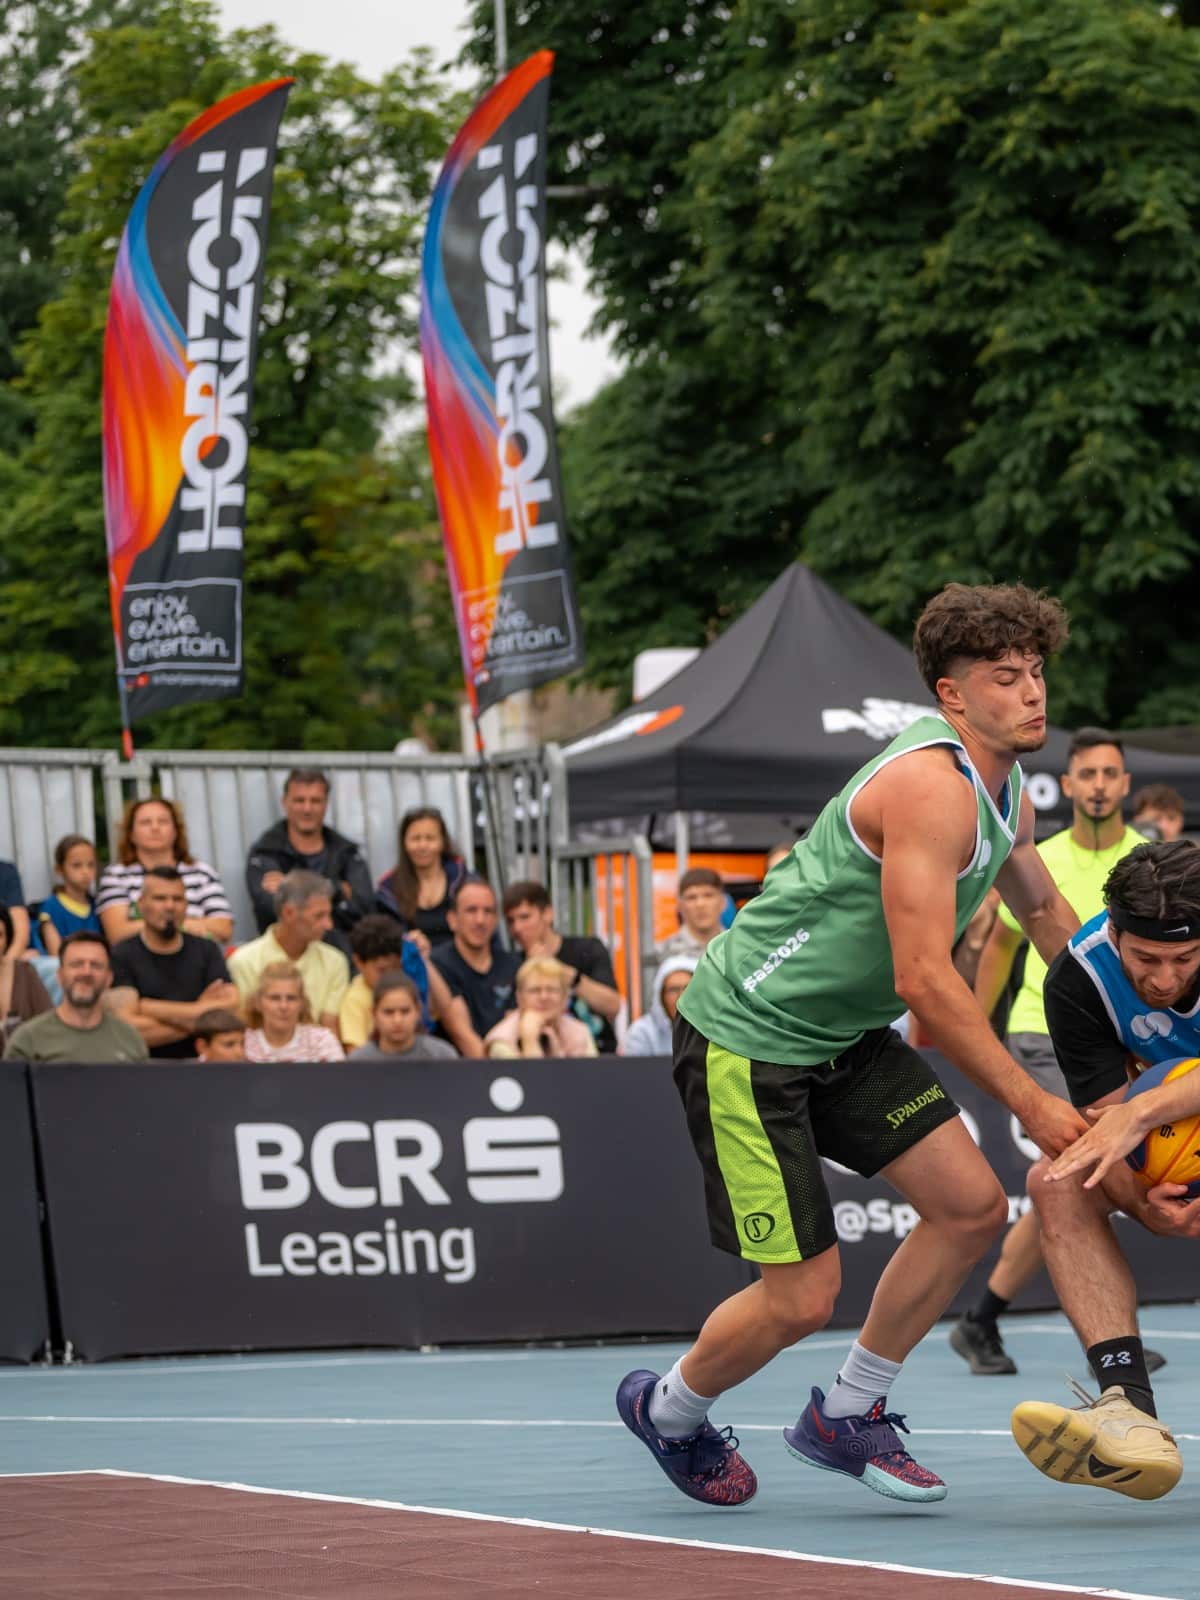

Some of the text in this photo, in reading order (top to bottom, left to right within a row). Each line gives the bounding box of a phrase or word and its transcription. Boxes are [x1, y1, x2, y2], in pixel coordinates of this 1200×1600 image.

[178, 147, 267, 553] HORIZON
[477, 133, 559, 554] HORIZON
[885, 1083, 946, 1130] SPALDING
[234, 1119, 451, 1210] BCR
[245, 1218, 477, 1283] Leasing
[1100, 1351, 1132, 1368] 23
